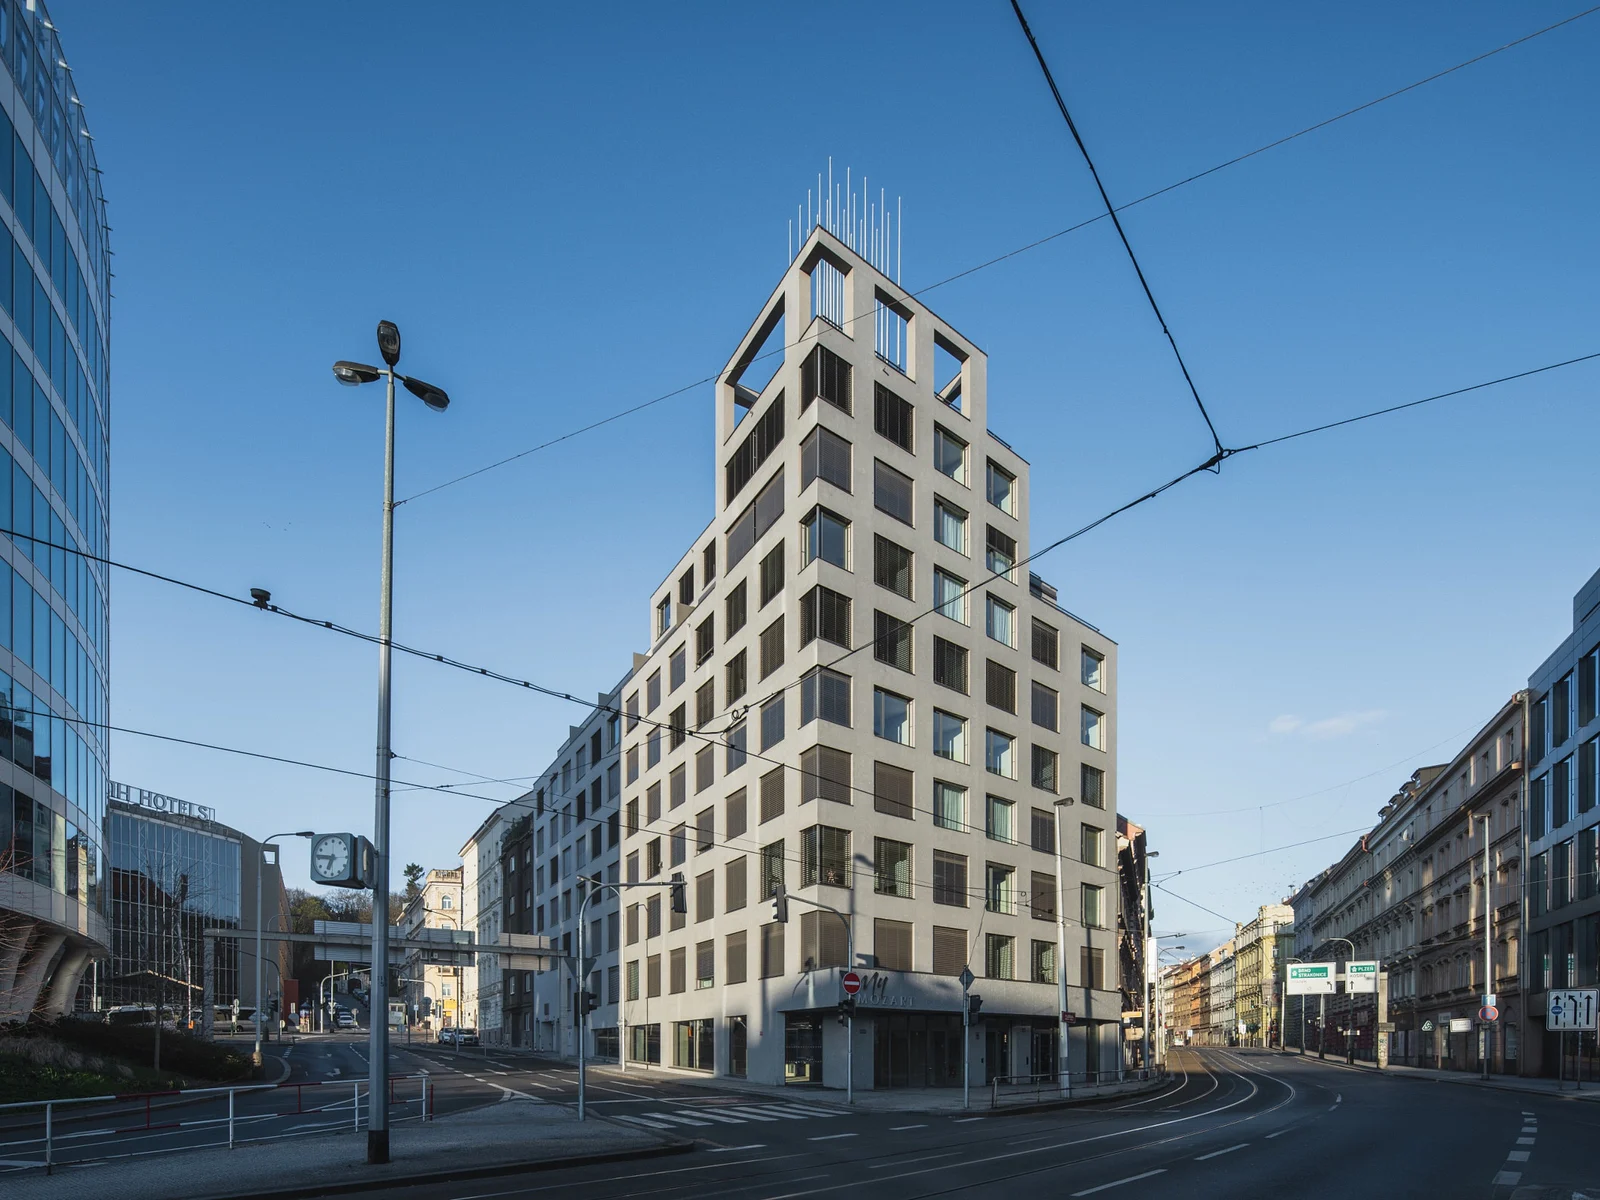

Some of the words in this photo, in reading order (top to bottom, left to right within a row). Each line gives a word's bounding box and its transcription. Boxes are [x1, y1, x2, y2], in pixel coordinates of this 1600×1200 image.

[140, 789, 210, 821] HOTELS
[861, 971, 888, 999] My
[857, 993, 916, 1007] MOZART
